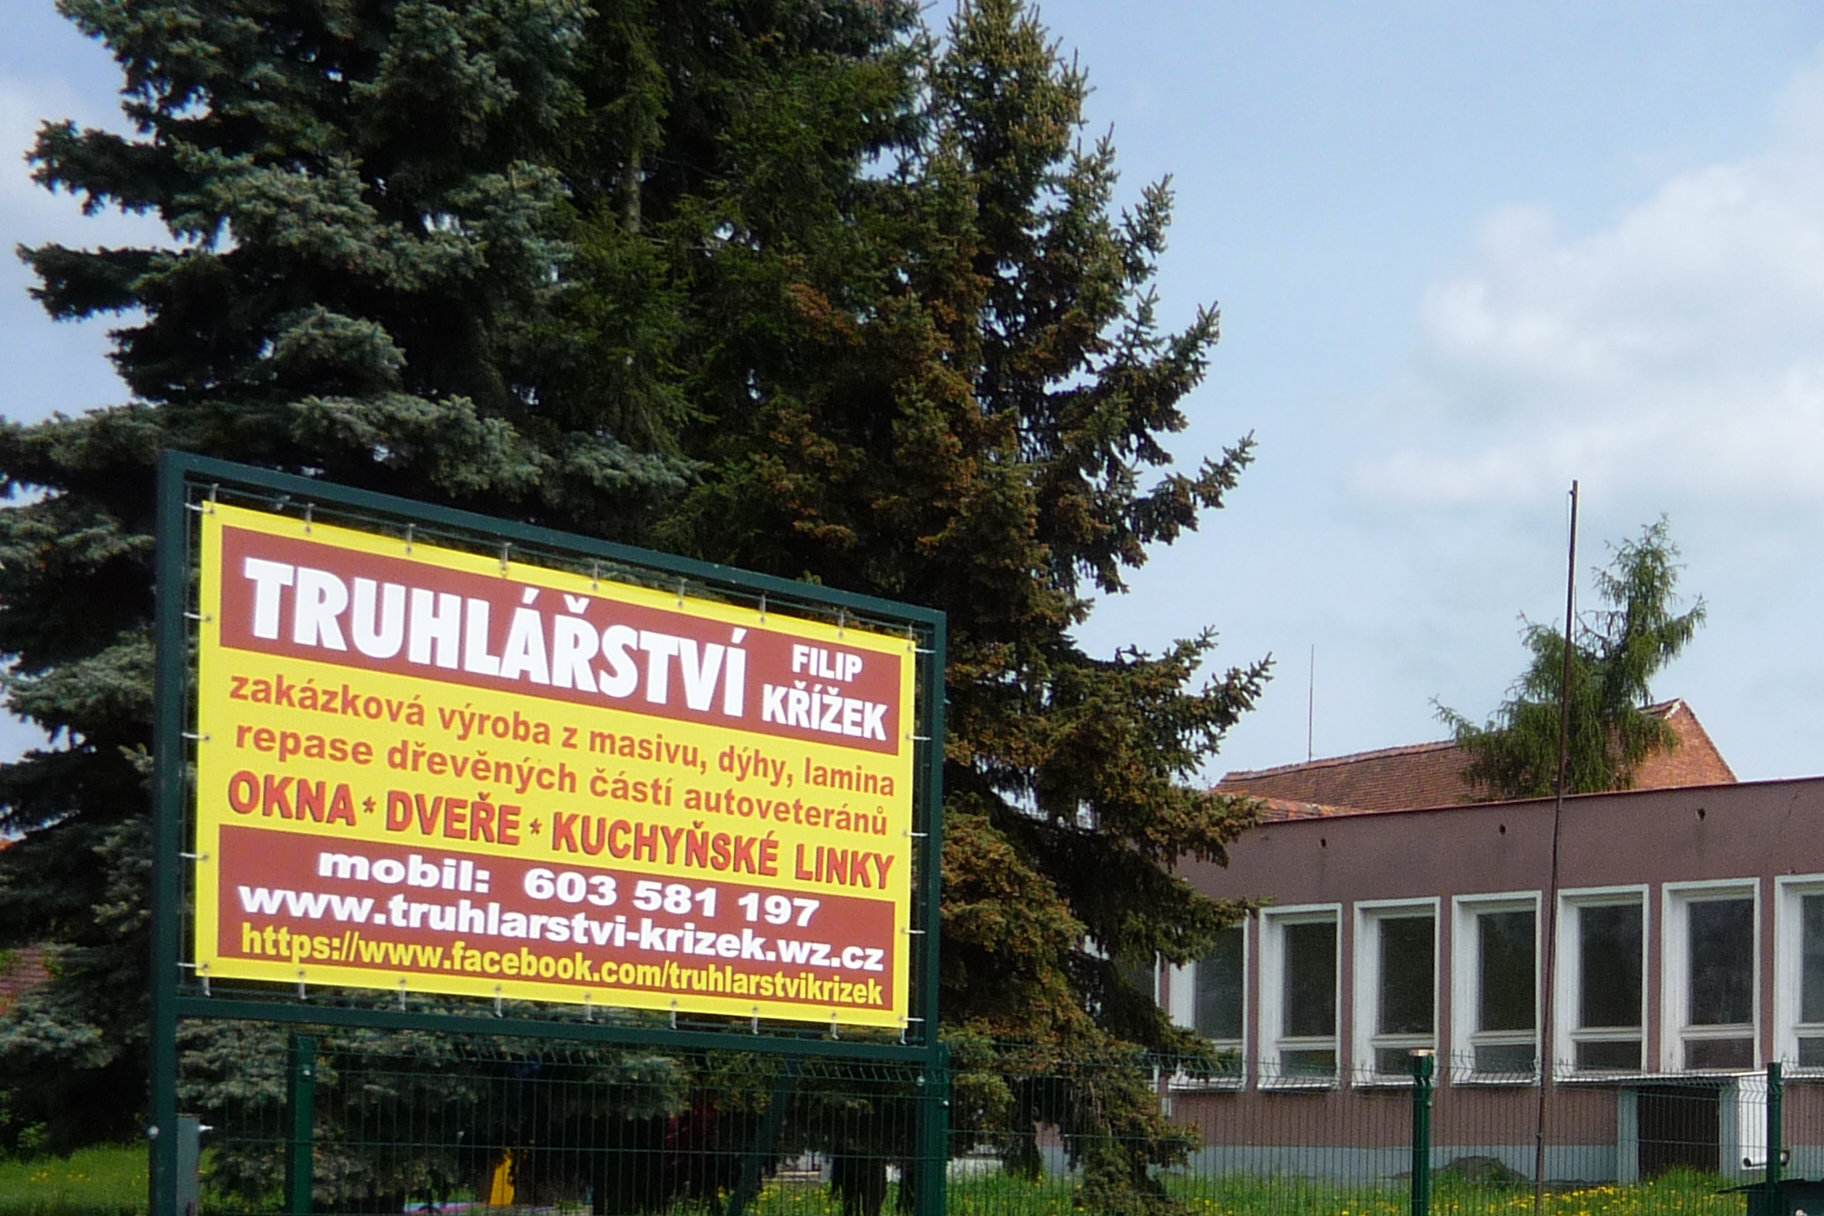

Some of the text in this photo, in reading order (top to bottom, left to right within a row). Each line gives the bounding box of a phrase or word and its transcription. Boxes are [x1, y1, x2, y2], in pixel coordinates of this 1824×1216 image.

[244, 557, 748, 717] TRUHLÁŘSTVÍ
[792, 644, 864, 683] FILIP
[229, 673, 895, 797] zakázková výroba z masivu, dýhy, lamina
[762, 681, 889, 741] KŘÍŽEK
[236, 724, 888, 836] repase dřevěných částí autoveteránů
[228, 770, 895, 890] OKNA DVEŘE KUCHYŇSKÉ LINKY
[238, 884, 884, 972] www.truhlarstvi-krizek.wz.cz
[319, 852, 820, 928] mobil: 603 581 197
[241, 922, 883, 1006] https://www.facebook.com/truhlarstvikrizek
